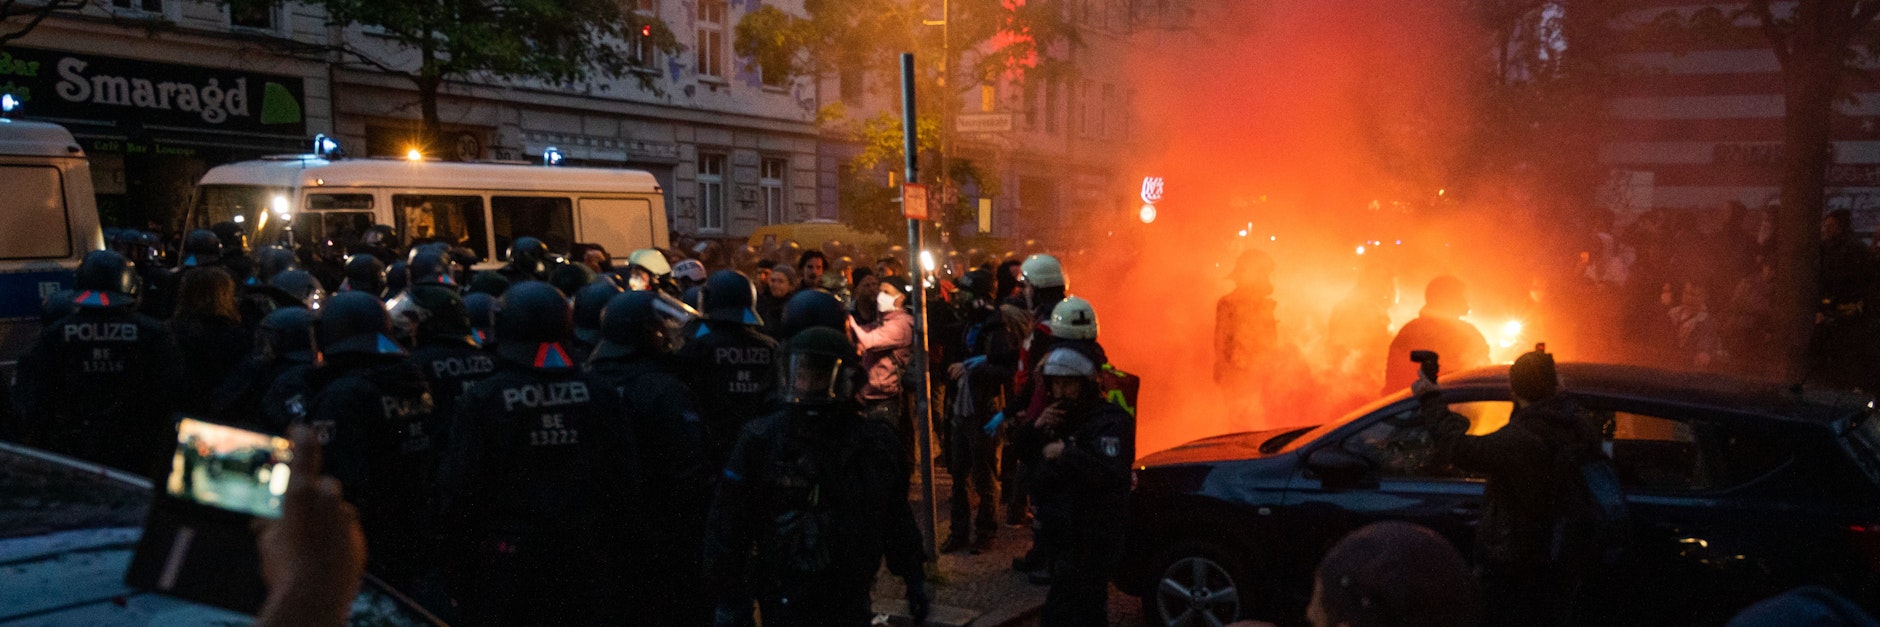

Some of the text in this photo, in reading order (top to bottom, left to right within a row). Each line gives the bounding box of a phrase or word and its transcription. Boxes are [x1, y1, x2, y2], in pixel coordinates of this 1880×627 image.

[0, 51, 40, 77] Bar
[55, 56, 249, 124] Smaragd
[64, 322, 139, 343] POLIZEI
[503, 381, 590, 412] POLIZEI
[541, 413, 564, 429] BE
[530, 429, 579, 446] 13222
